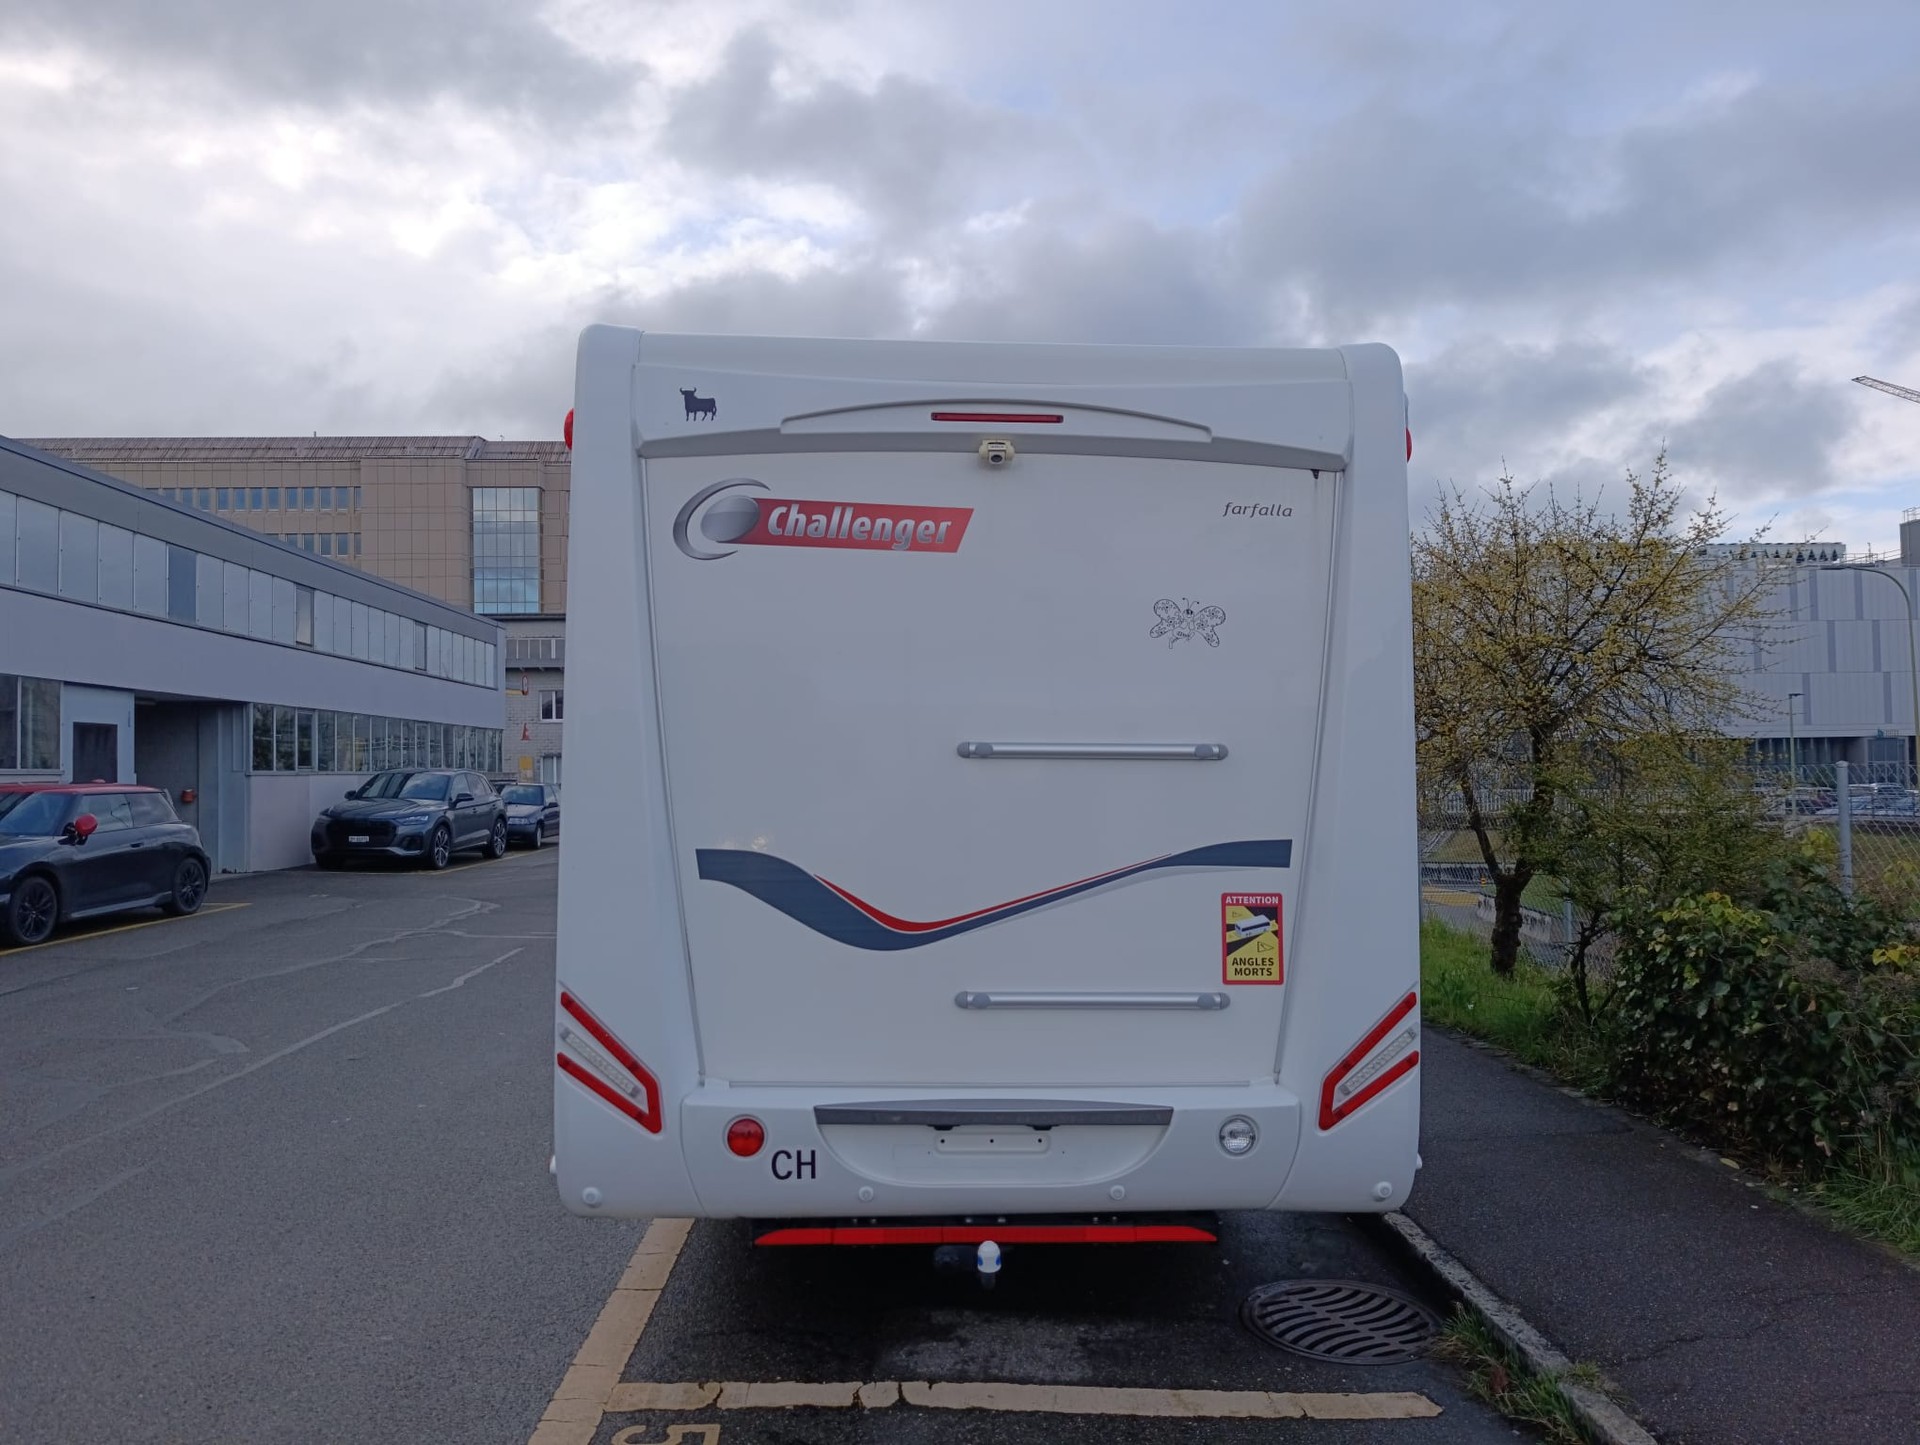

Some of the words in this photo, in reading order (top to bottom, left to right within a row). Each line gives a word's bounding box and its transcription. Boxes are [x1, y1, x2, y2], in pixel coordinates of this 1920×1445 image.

[1222, 502, 1293, 518] farfalla
[767, 503, 952, 550] Challenger
[1225, 896, 1279, 904] ATTENTION
[1231, 957, 1275, 967] ANGLES
[1234, 967, 1273, 976] MORTS
[771, 1149, 816, 1180] CH
